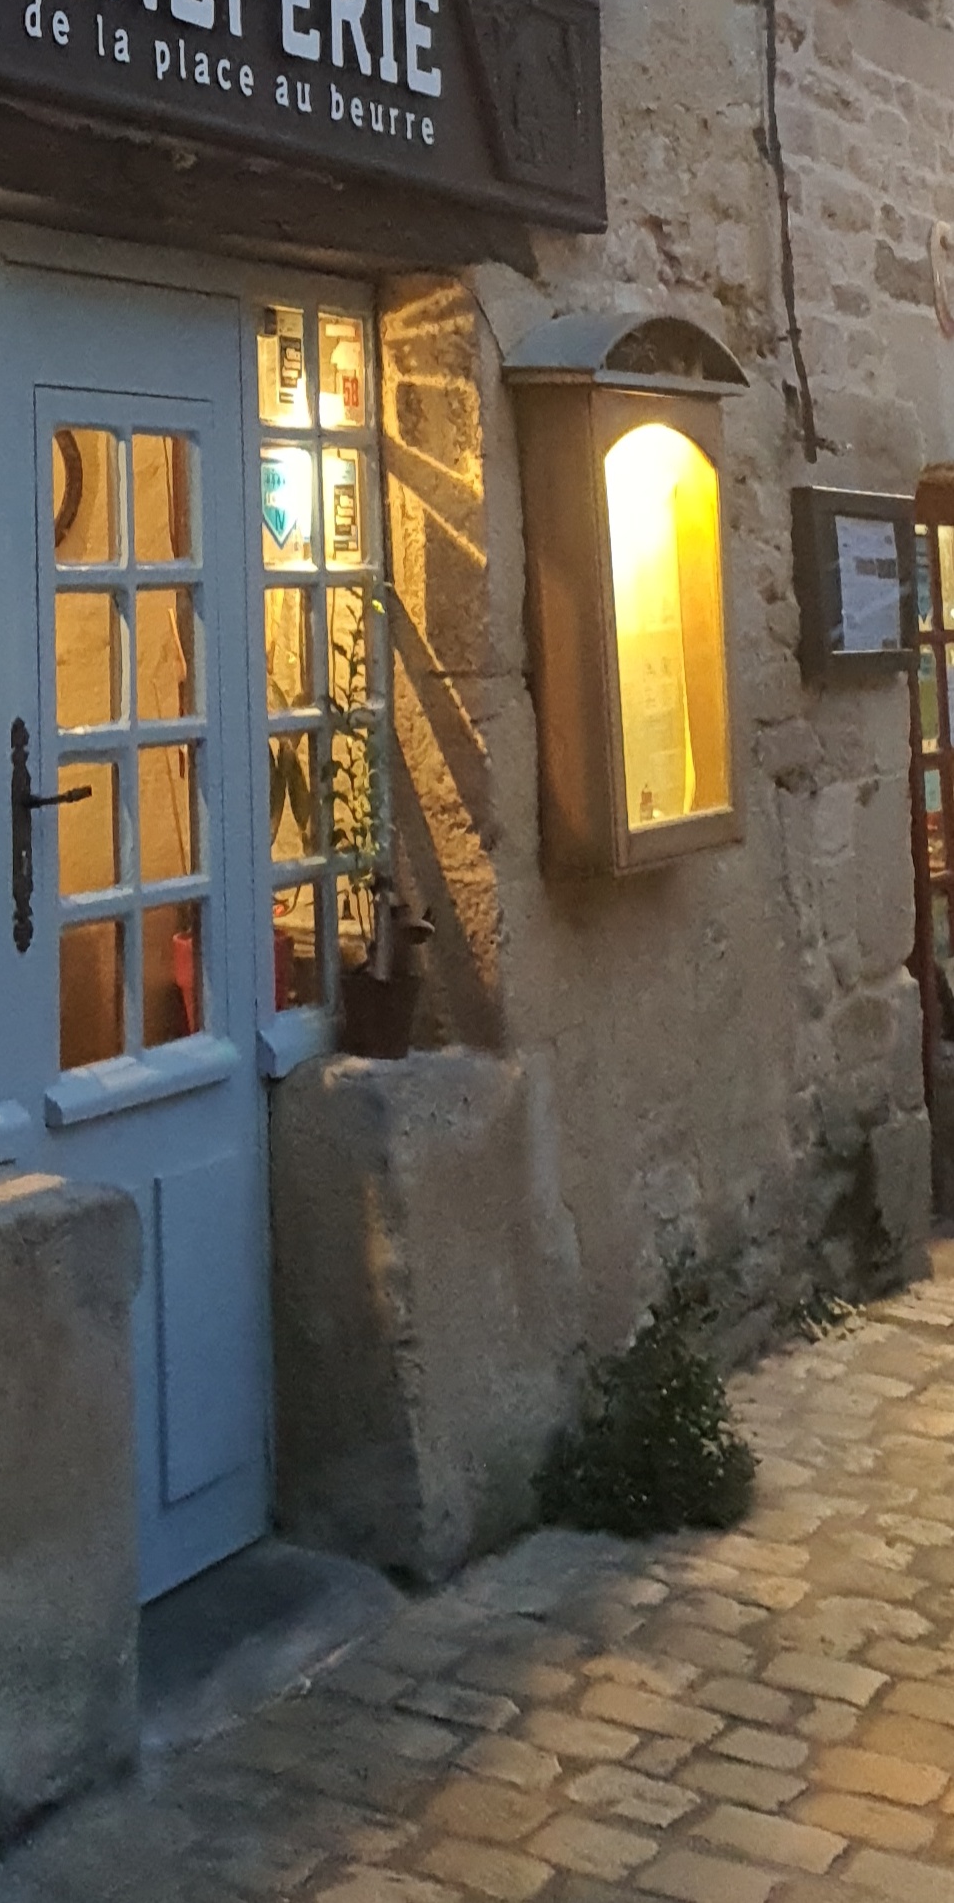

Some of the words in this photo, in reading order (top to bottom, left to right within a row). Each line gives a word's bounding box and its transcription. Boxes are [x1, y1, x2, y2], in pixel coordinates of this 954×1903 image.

[96, 15, 130, 63] la
[154, 40, 255, 97] place
[276, 74, 312, 114] au
[330, 85, 435, 146] beurre
